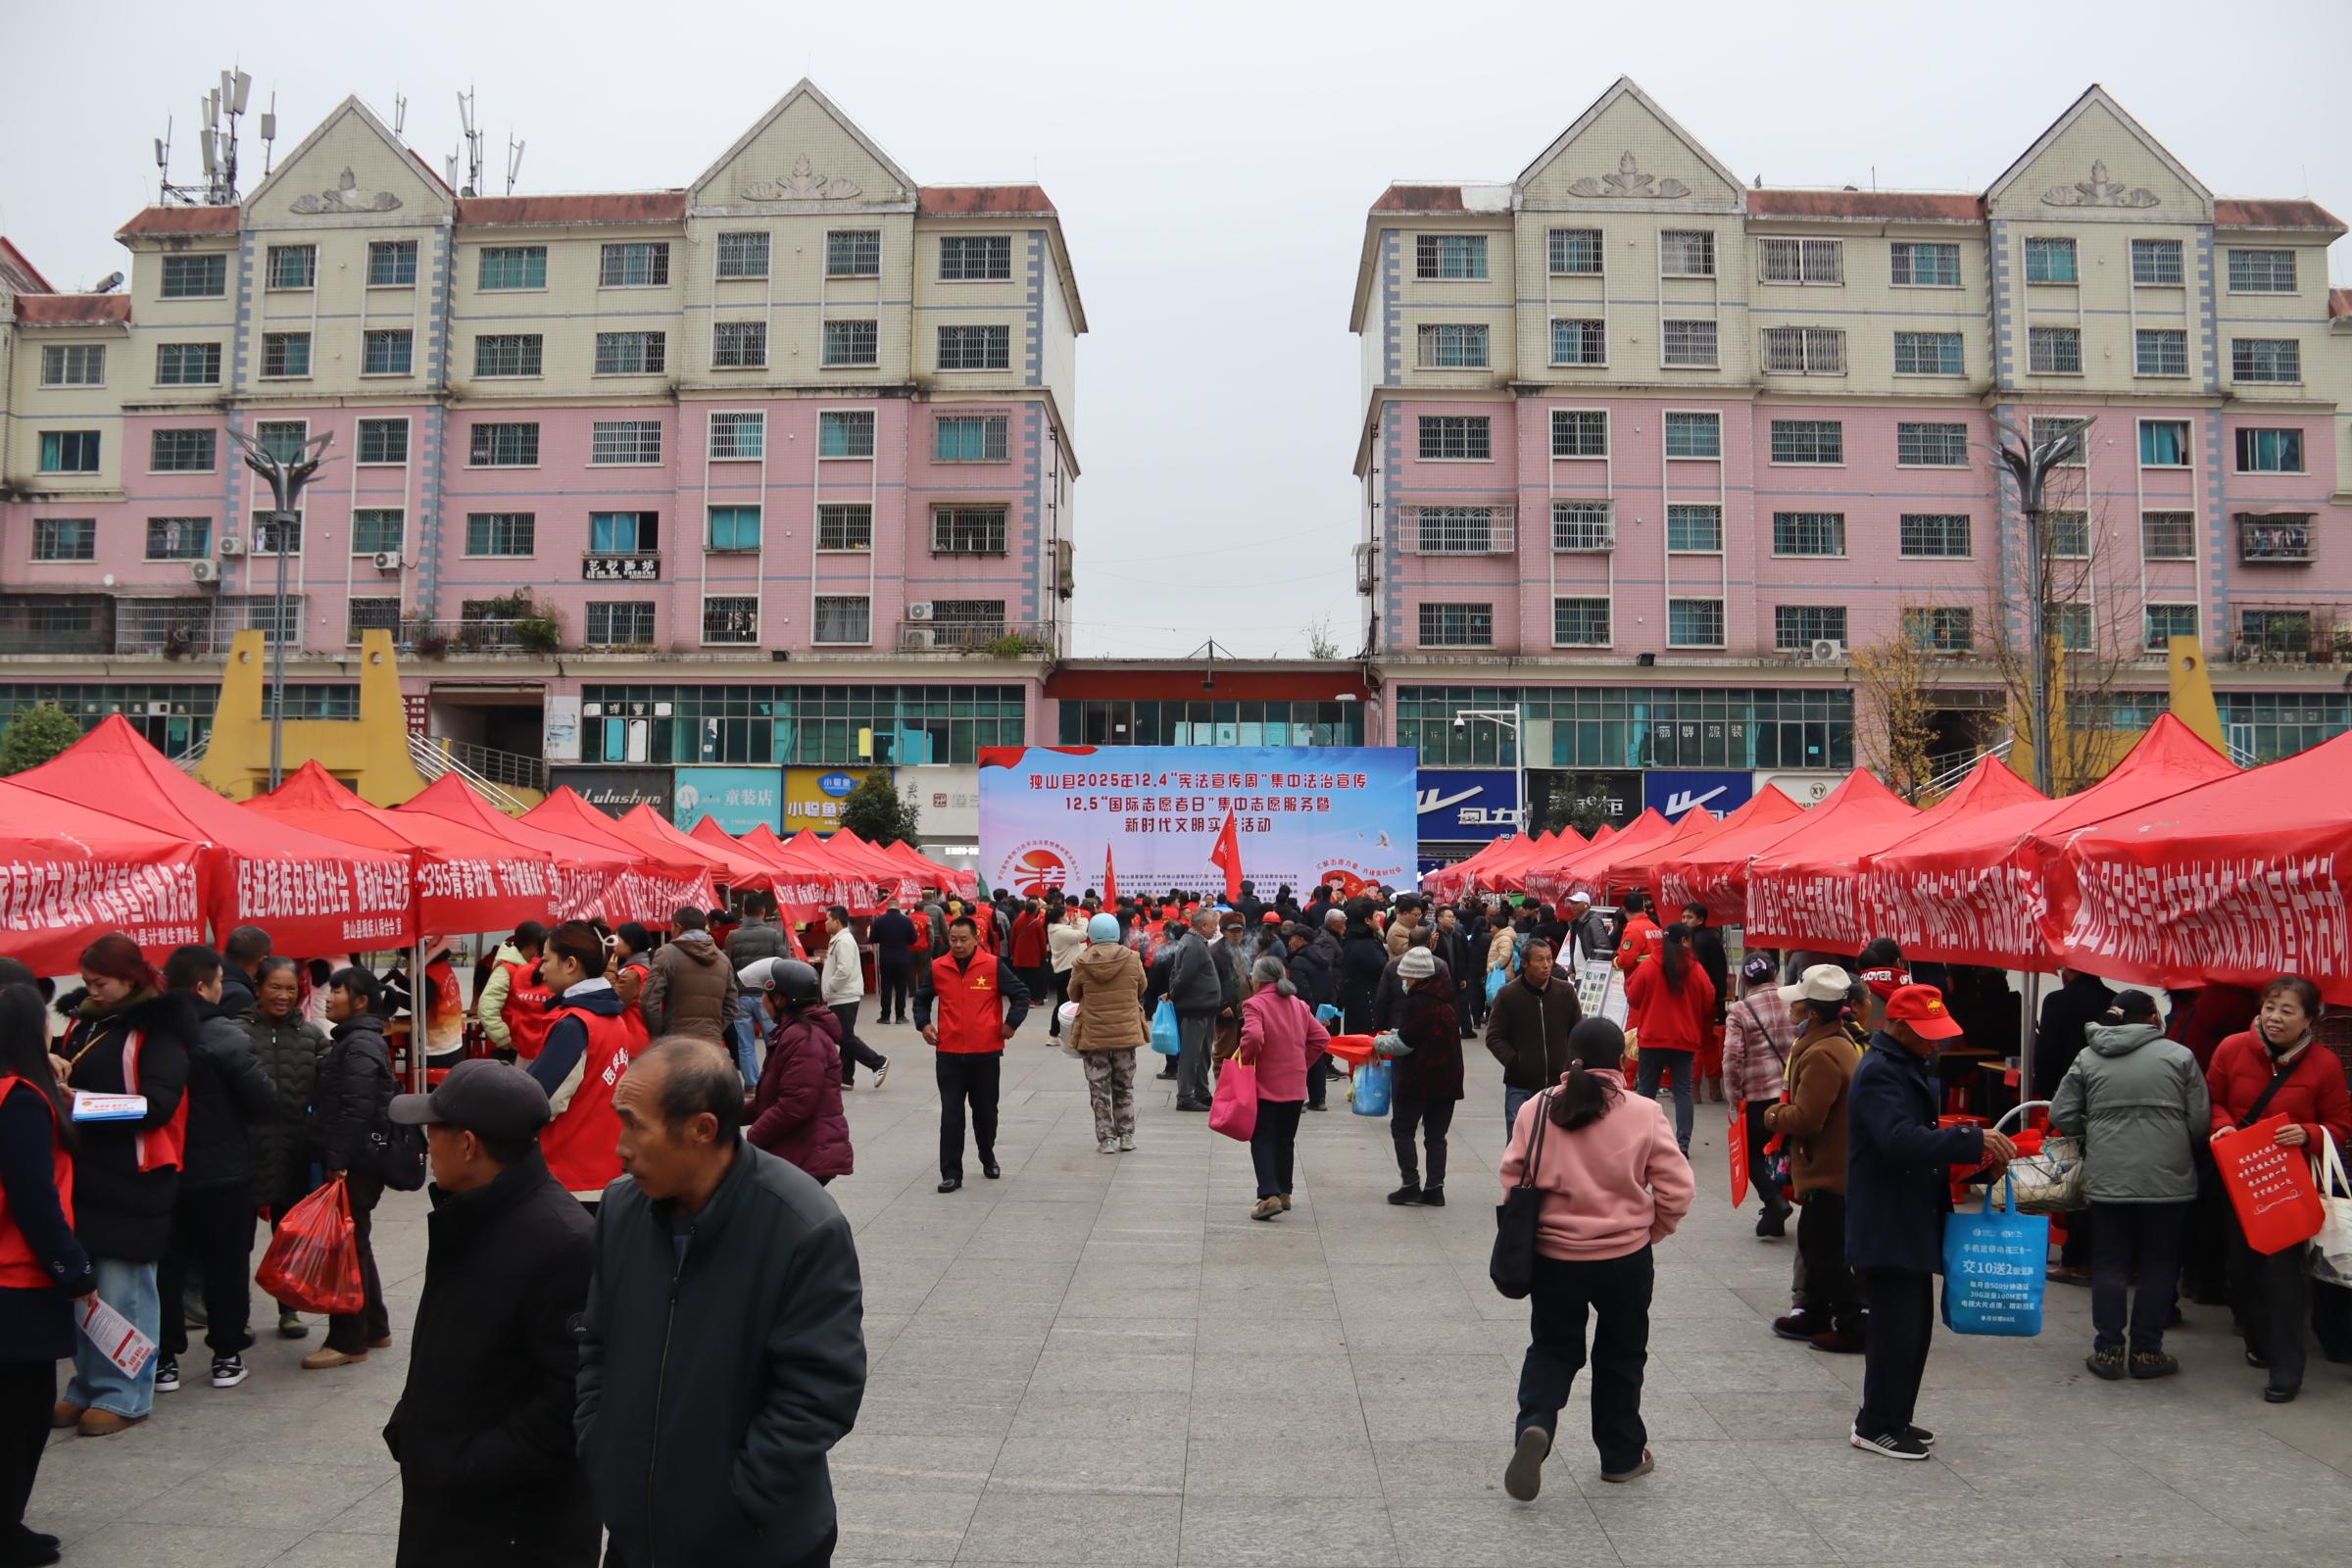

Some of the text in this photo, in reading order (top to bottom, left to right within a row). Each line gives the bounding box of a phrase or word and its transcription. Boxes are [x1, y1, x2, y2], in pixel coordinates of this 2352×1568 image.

[726, 789, 773, 807] 童装店
[1125, 816, 1272, 833] 新时代文明实活动
[116, 926, 200, 947] 山县计划生育协会
